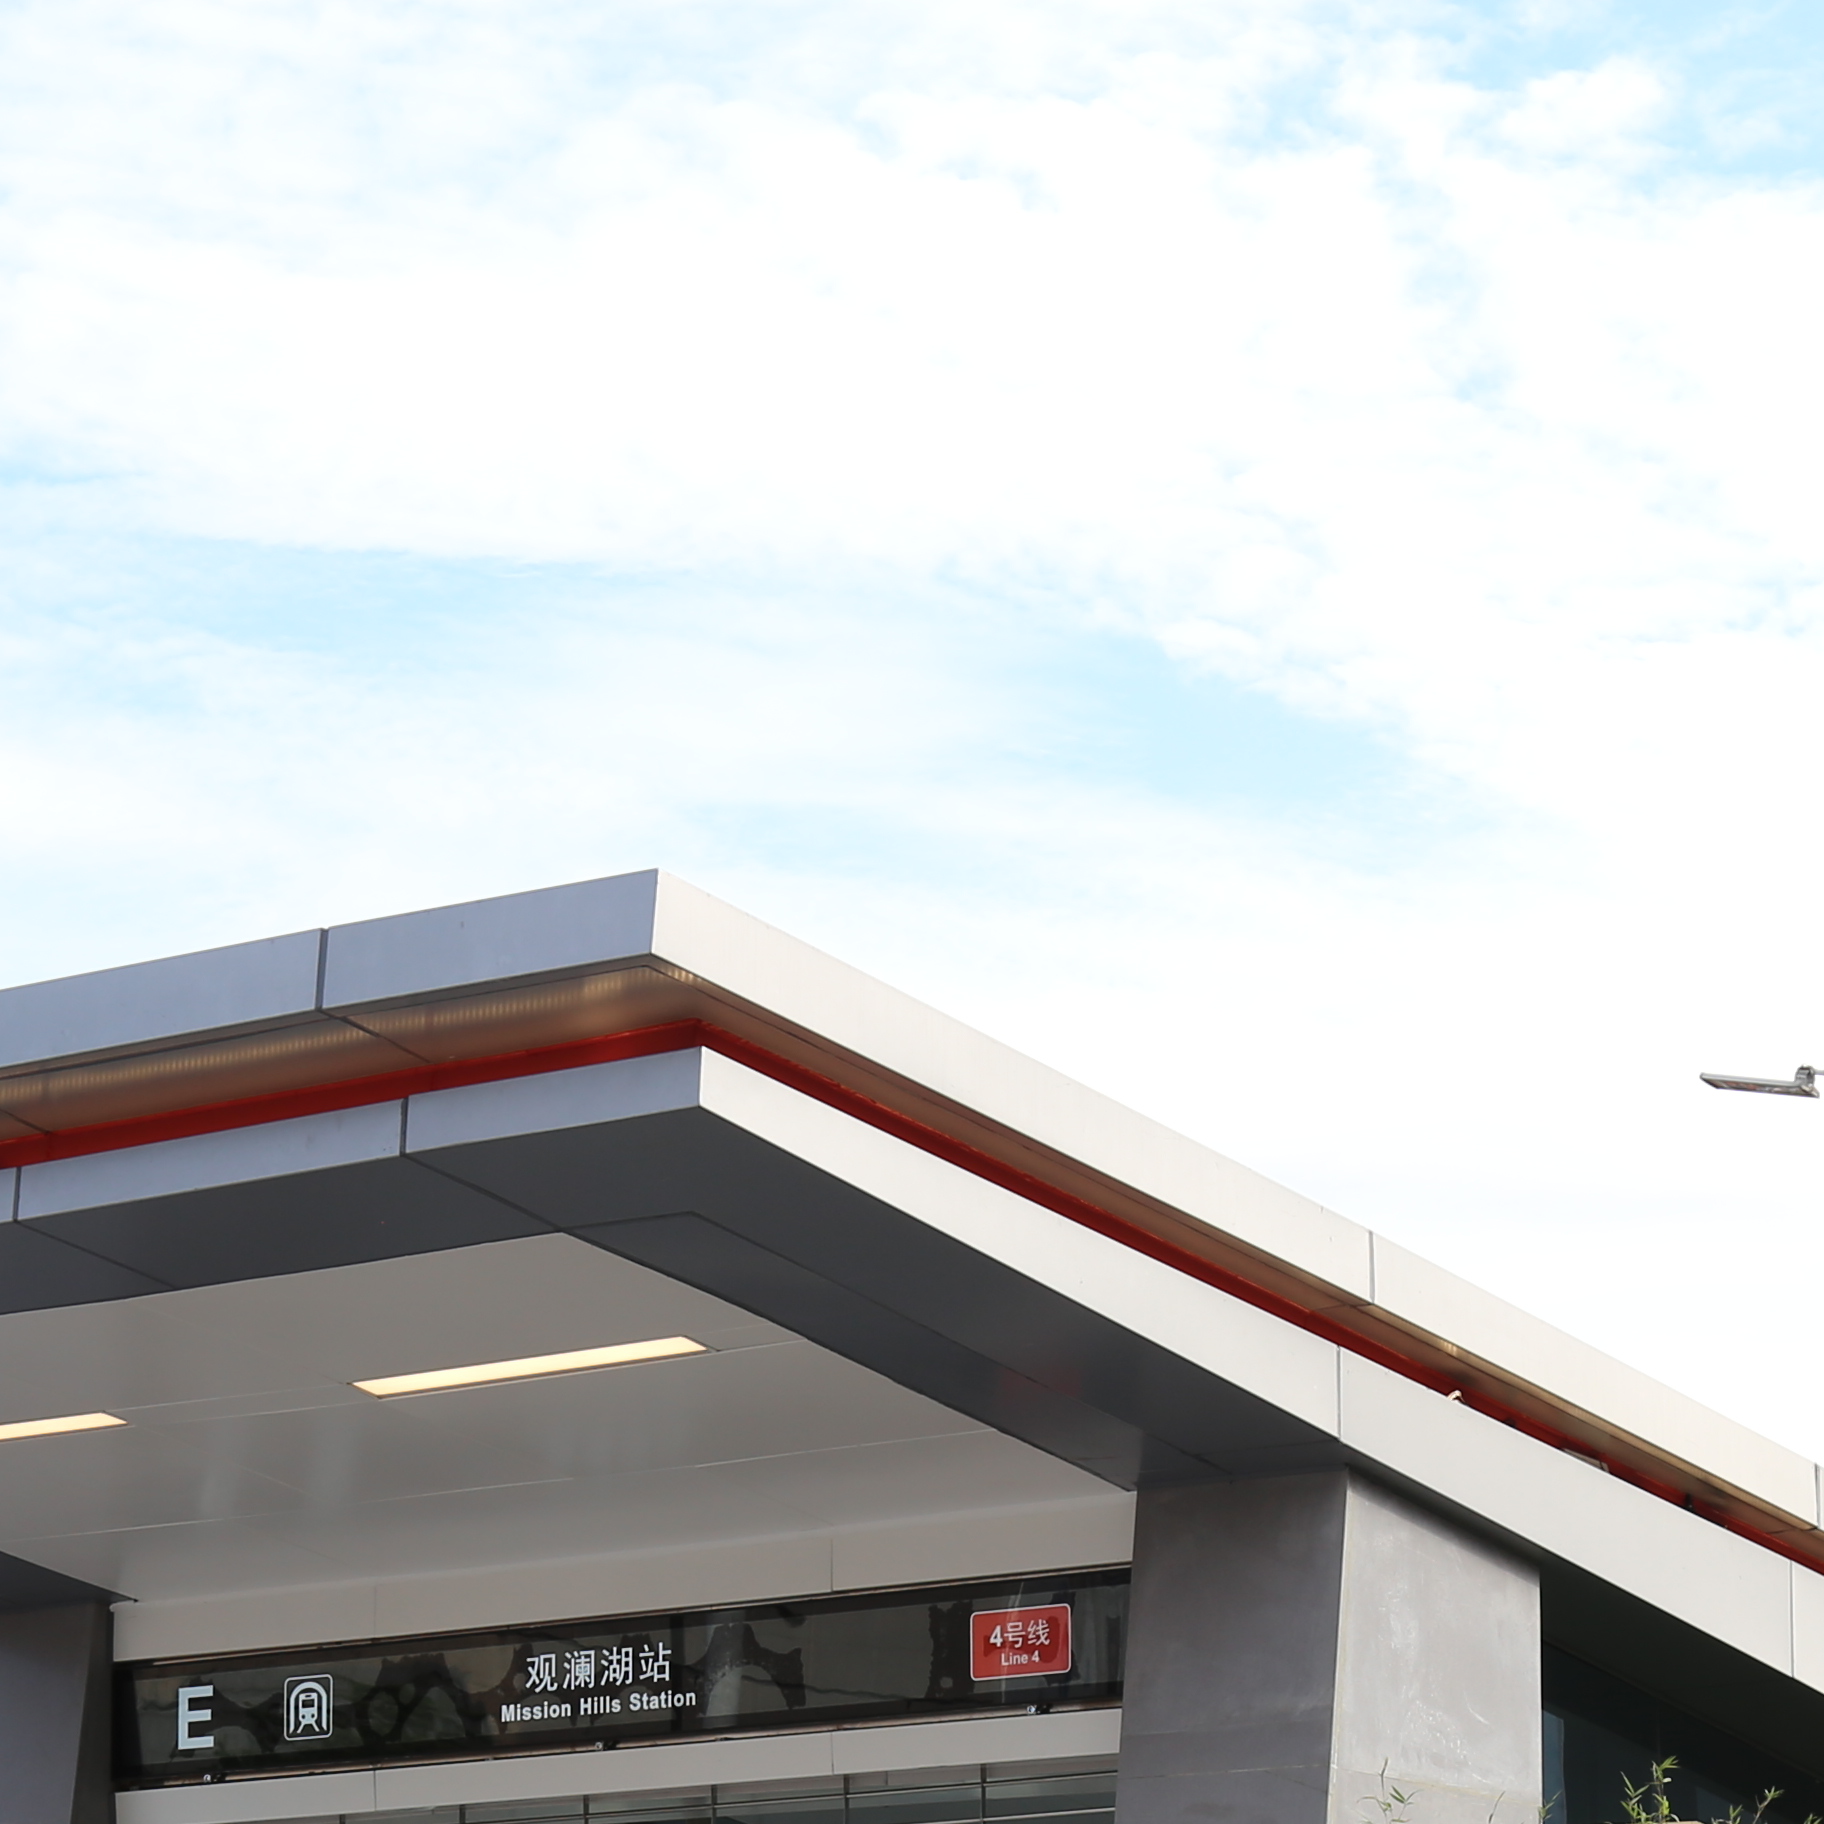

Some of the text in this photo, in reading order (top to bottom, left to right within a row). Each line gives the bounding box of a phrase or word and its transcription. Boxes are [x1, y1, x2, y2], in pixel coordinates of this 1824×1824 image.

[989, 1619, 1051, 1648] 4号线
[525, 1642, 673, 1693] 观澜湖站
[1001, 1650, 1040, 1666] Line 4
[177, 1683, 216, 1750] E
[501, 1689, 697, 1723] Mission Hills Station
